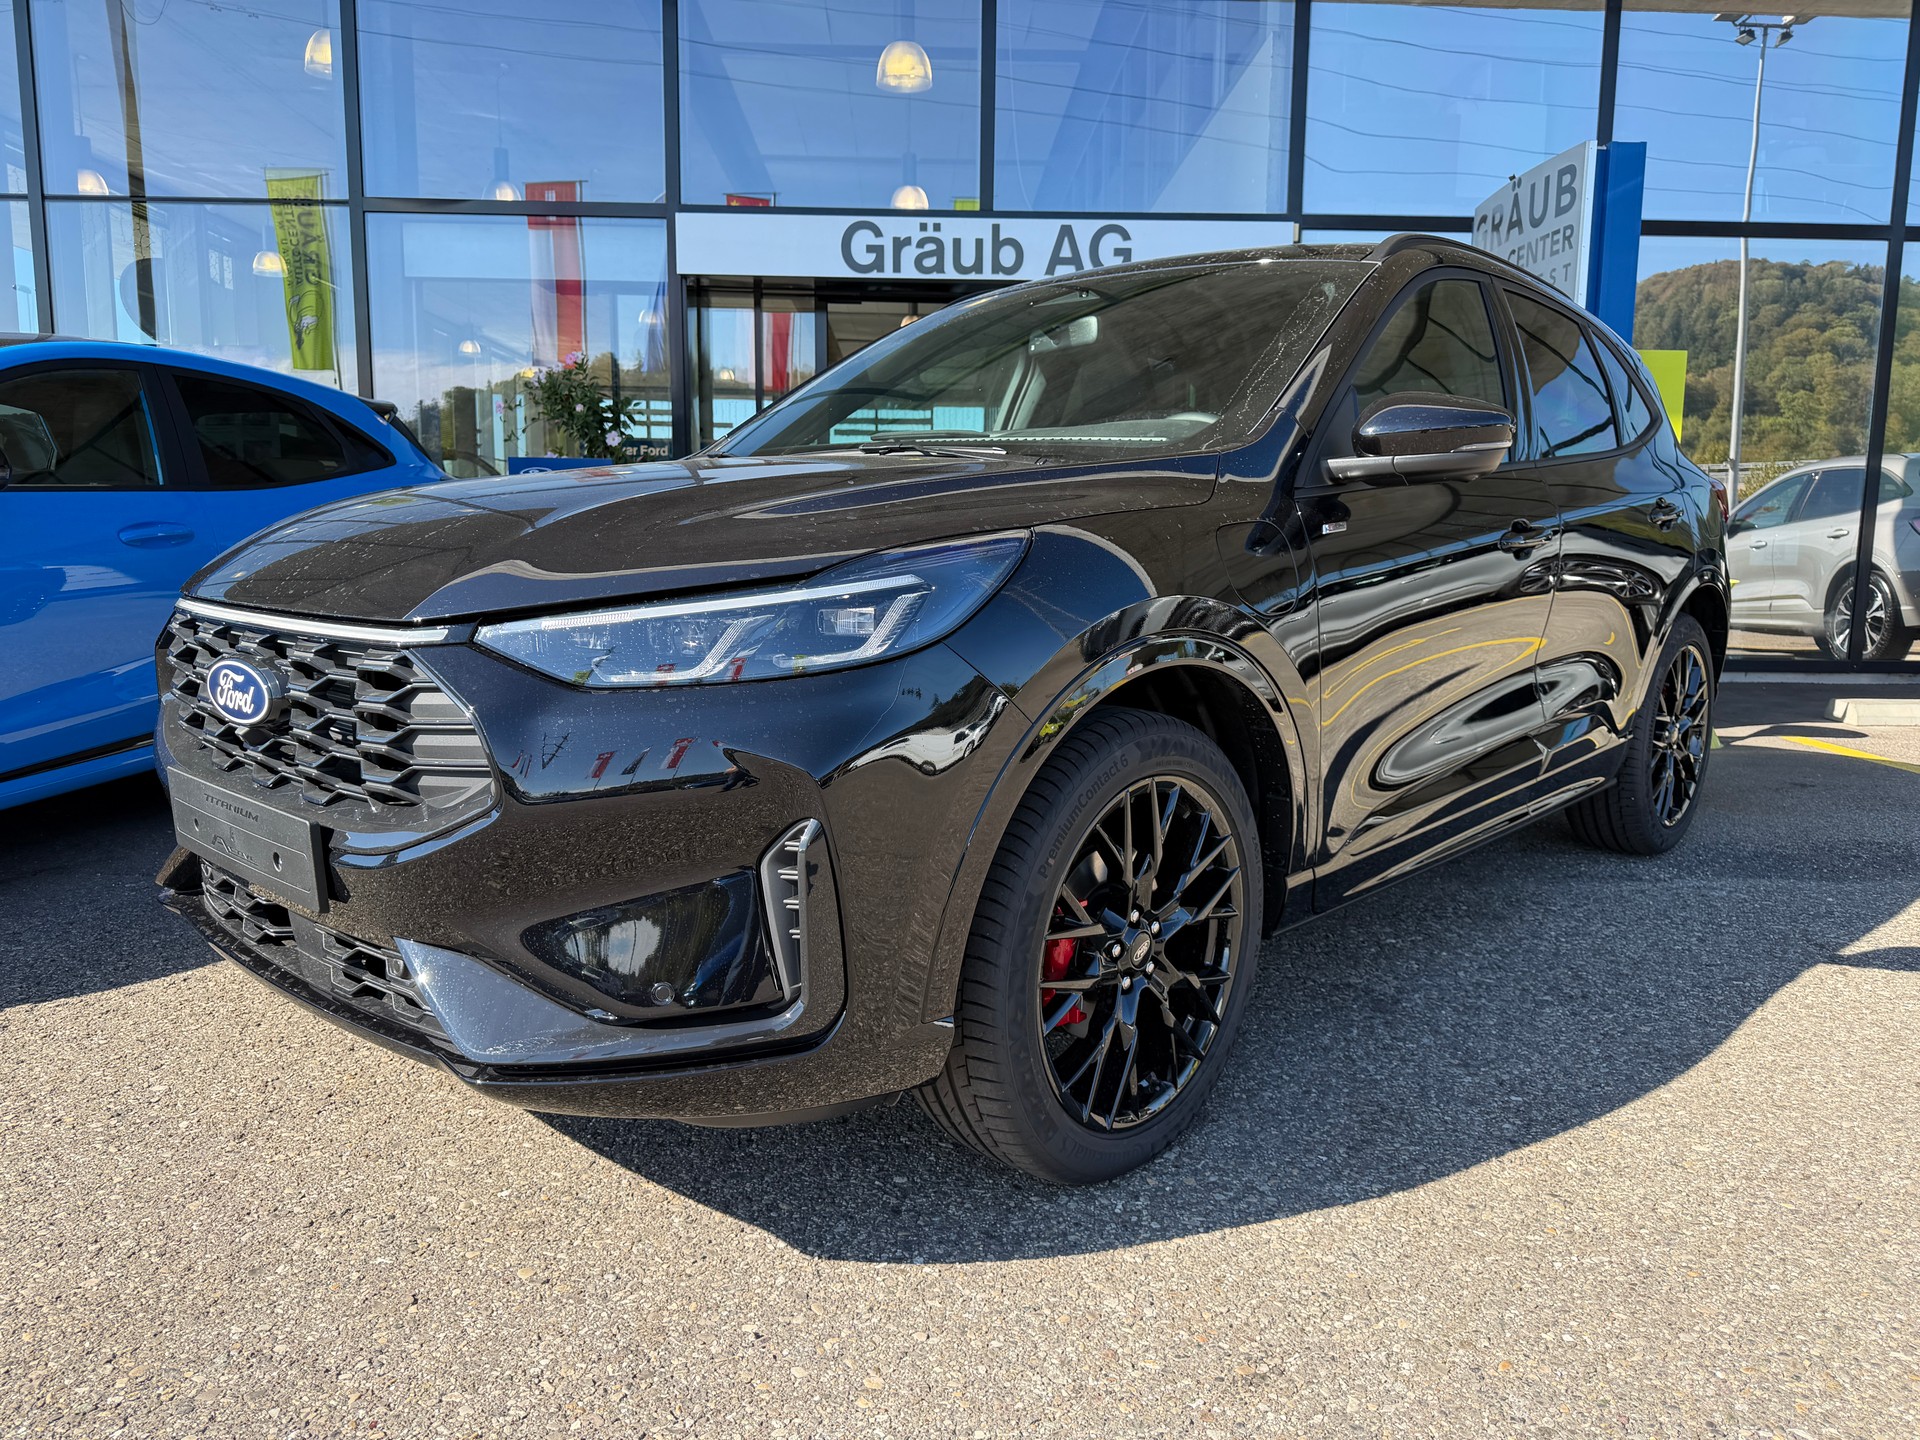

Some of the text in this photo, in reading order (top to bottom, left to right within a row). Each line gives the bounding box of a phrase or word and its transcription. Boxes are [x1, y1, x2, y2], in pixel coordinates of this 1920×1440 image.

[840, 219, 1132, 276] Gräub AG
[640, 444, 669, 456] Ford
[204, 793, 259, 822] TITANIUM
[1036, 753, 1130, 879] PremiumContact 6
